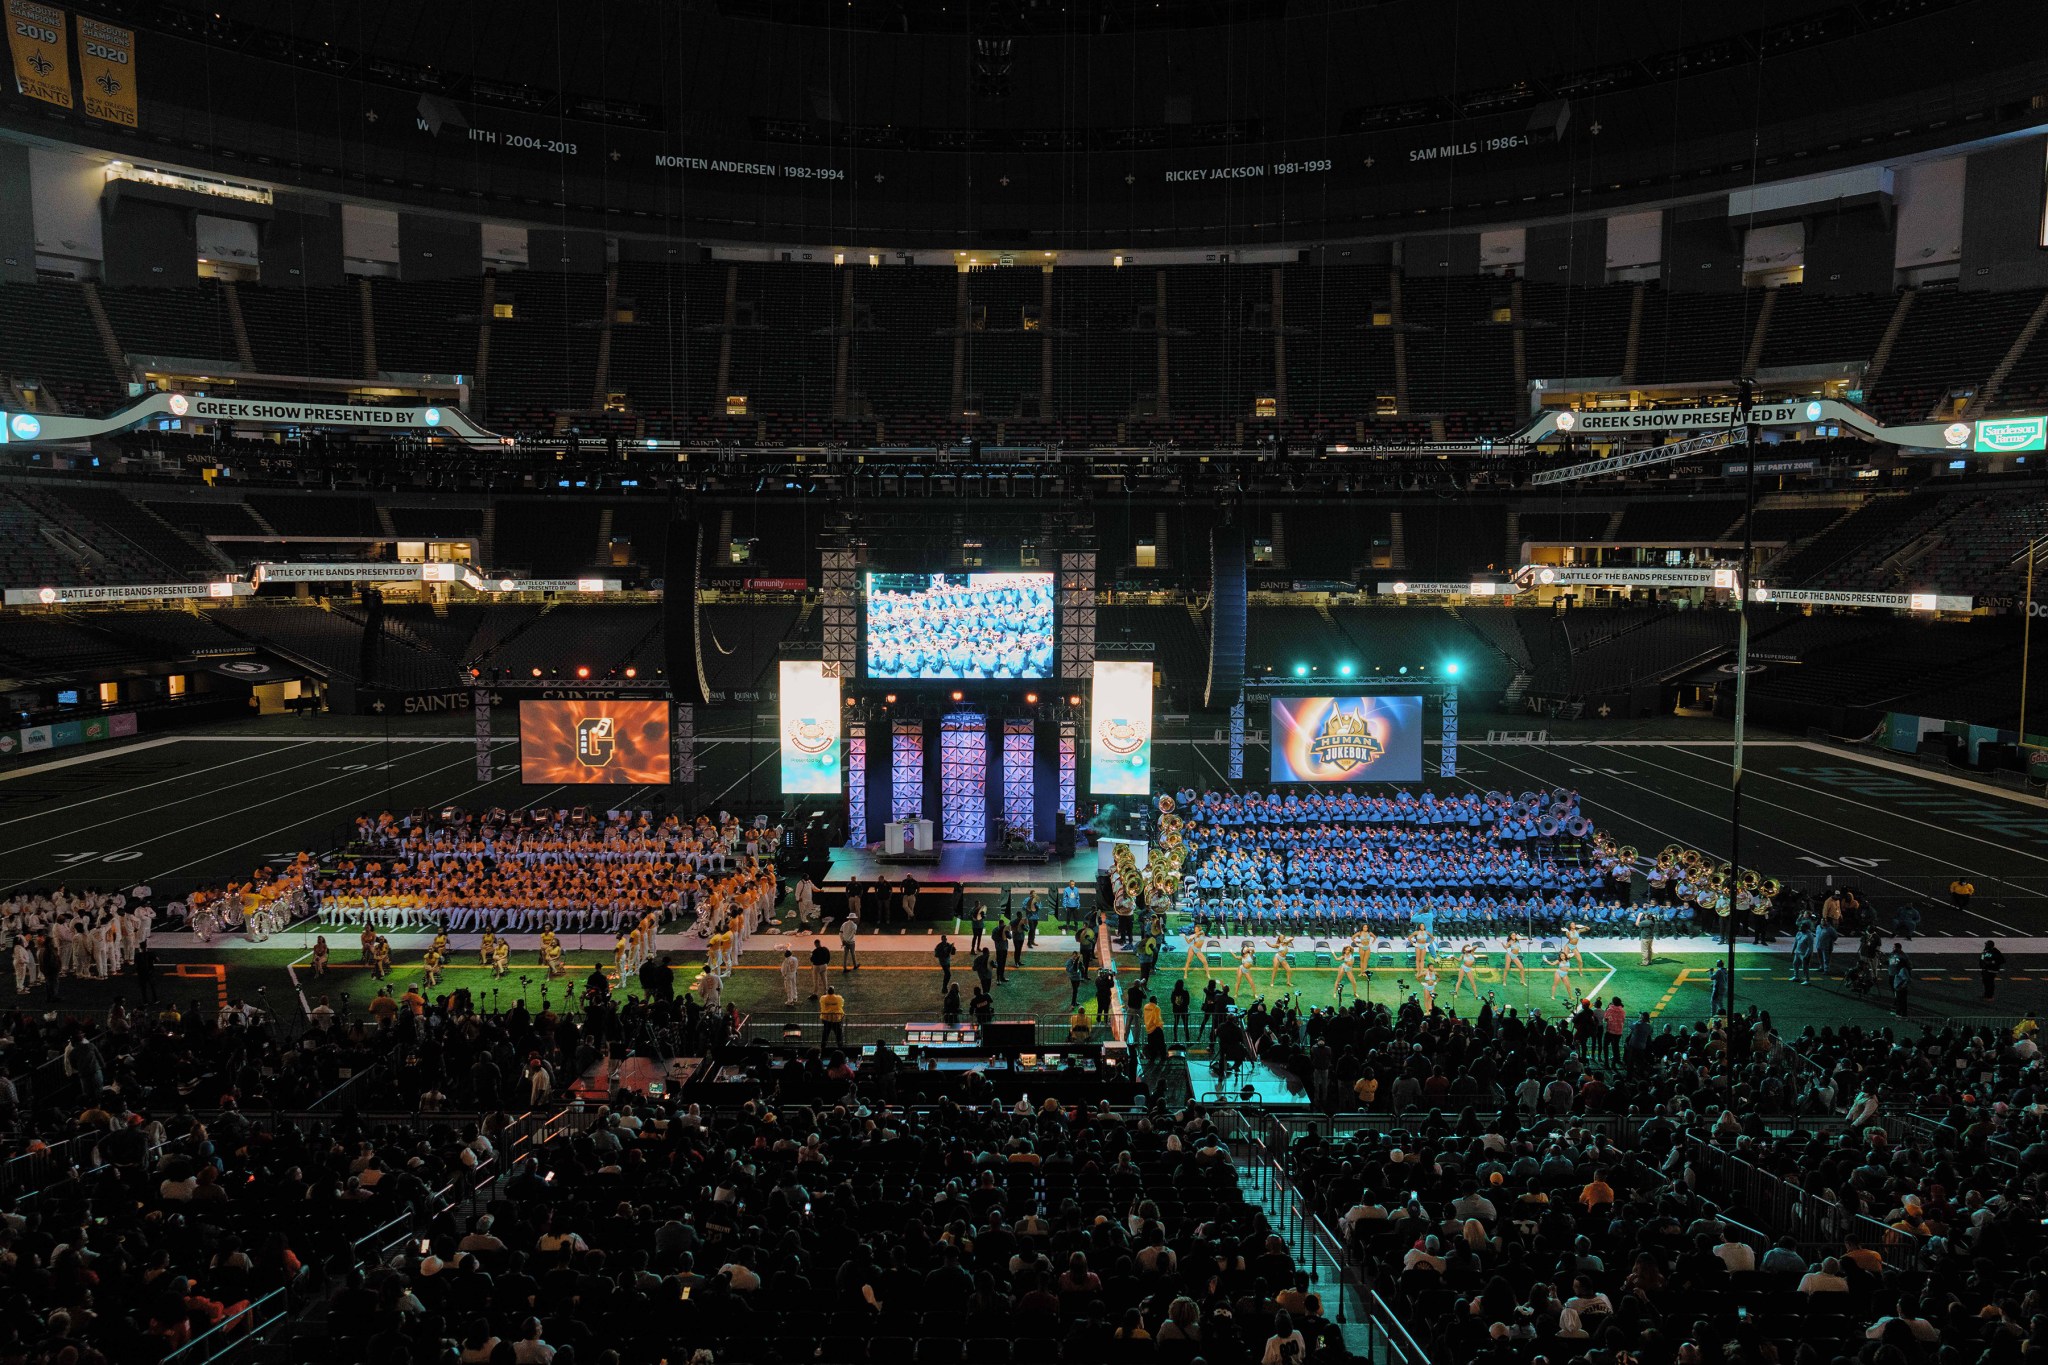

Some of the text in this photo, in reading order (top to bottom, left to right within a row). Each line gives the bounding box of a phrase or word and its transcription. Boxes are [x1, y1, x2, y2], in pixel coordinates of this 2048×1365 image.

[9, 6, 61, 27] CHAMPIONS
[28, 4, 58, 18] SOUTH
[16, 20, 57, 44] 2019
[82, 29, 130, 47] CHAMPIONS
[101, 24, 128, 38] SOUTH
[85, 41, 128, 64] 2020
[21, 82, 69, 105] SAINTS
[87, 103, 134, 124] SAINTS
[469, 128, 578, 156] ITH 2004-2013
[1409, 134, 1529, 163] SAM MILLS 1986-1
[655, 155, 845, 181] MORTEN ANDERSEN 1982-1994
[1165, 159, 1332, 182] RICKEY JACKSON 1981-1993
[196, 401, 415, 423] GREEK SHOW PRESENTED BY
[1582, 408, 1797, 429] GREEK SHOW PRESENTED BY
[1986, 425, 2035, 437] Sanderson
[1995, 434, 2028, 444] Farms
[187, 454, 218, 464] SAINTS
[1672, 466, 1703, 475] SAINTS
[1729, 465, 1744, 473] BUD
[1768, 463, 1793, 471] PARTY
[1794, 461, 1814, 470] ZONE
[294, 569, 307, 577] OF
[308, 569, 325, 577] THE
[326, 568, 355, 577] BANDS
[356, 568, 405, 576] PRESENTED
[406, 568, 417, 576] BY
[1560, 572, 1591, 580] BATTLE
[1591, 572, 1602, 580] OF
[1621, 573, 1651, 581] BANDS
[1651, 573, 1700, 582] PRESENTED
[1700, 574, 1711, 582] BY
[712, 579, 741, 588] SAINTS
[1260, 581, 1290, 589] SAINTS
[61, 585, 209, 599] BATTLE OF THE BANDS PRESENTED BY
[1771, 590, 1909, 604] BATTLE OF THE BANDS PRESENTED BY
[1979, 597, 2013, 608] SAINTS
[404, 693, 470, 713] SAINTS
[580, 728, 588, 754] BAND
[1321, 735, 1373, 746] HUMAN
[1325, 747, 1368, 761] JUKEBOX
